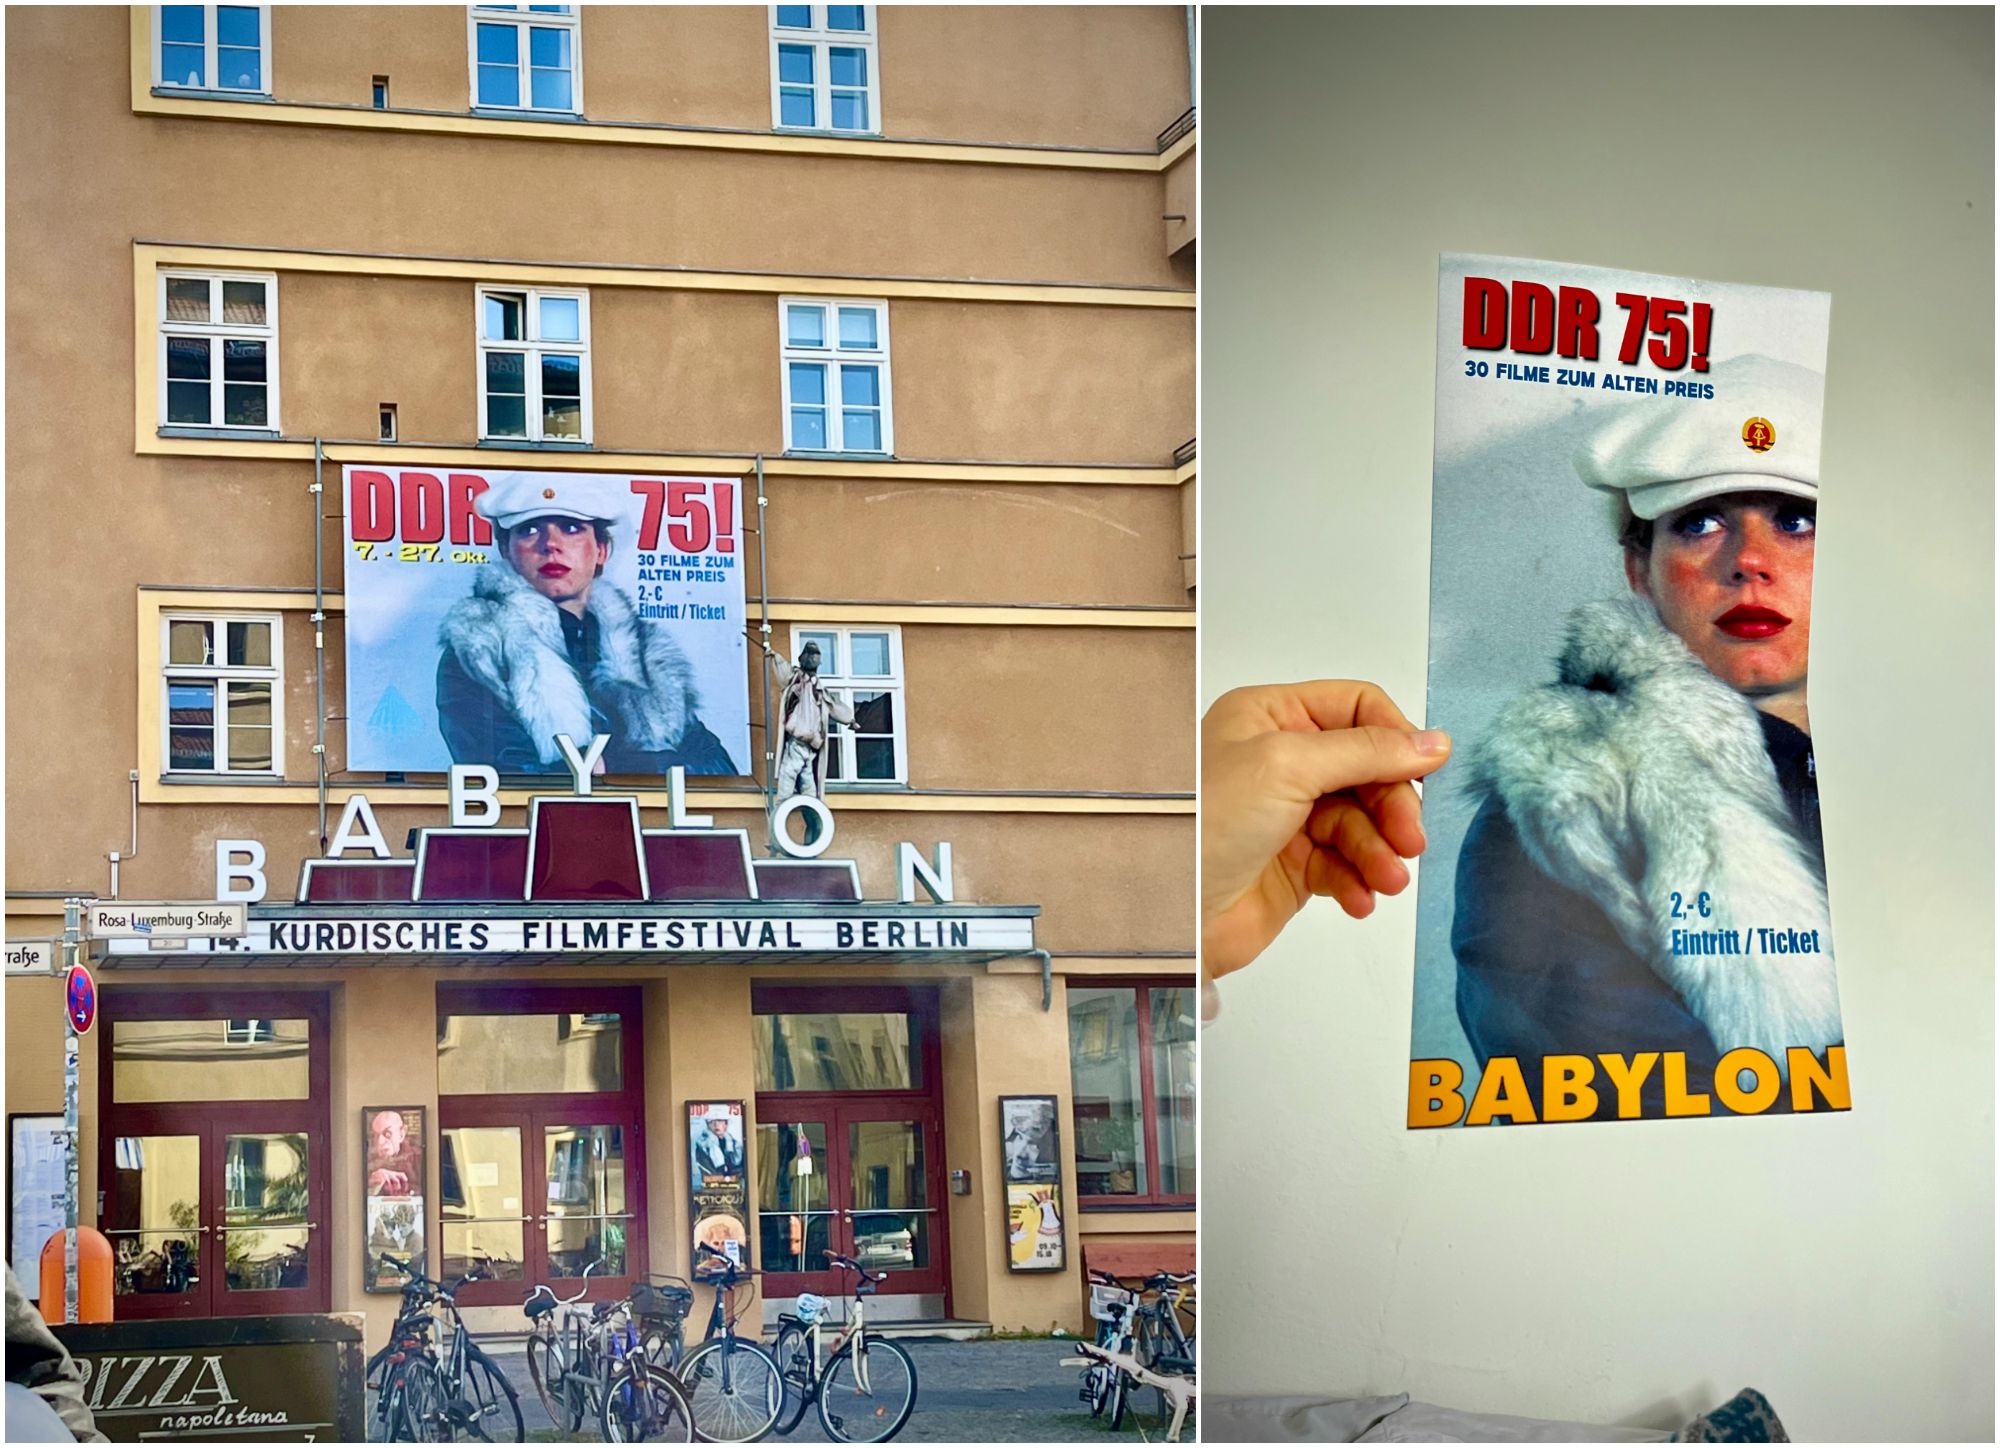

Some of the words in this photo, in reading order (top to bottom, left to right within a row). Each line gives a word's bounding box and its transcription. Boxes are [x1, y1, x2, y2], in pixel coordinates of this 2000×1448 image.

[1462, 276, 1599, 361] DDR
[1615, 291, 1715, 374] 75!
[1464, 360, 1489, 378] 30
[1496, 363, 1550, 384] FILME
[1557, 369, 1596, 389] ZUM
[1601, 373, 1658, 395] ALTEN
[1664, 380, 1714, 400] PREIS
[350, 470, 493, 546] DDR
[630, 480, 735, 554] 75!
[353, 542, 378, 561] 7.
[399, 544, 444, 563] 27.
[452, 550, 491, 564] Okt.
[637, 554, 656, 566] 30
[660, 555, 700, 568] FILME
[705, 556, 734, 568] ZUM
[638, 568, 682, 582] ALTEN
[686, 570, 726, 583] PREIS
[639, 602, 679, 619] Eintritt
[689, 604, 726, 620] Ticket
[215, 734, 954, 904] BABYLON
[270, 921, 490, 951] KURDISCHES
[523, 921, 802, 950] FILMFESTIVAL
[836, 921, 969, 949] BERLIN
[1672, 929, 1741, 956] Eintritt
[1745, 928, 1753, 955] /
[1757, 927, 1820, 954] Ticket
[5, 946, 39, 967] raße
[1407, 1046, 1852, 1129] BABYLON
[160, 1406, 288, 1430] napoletana
